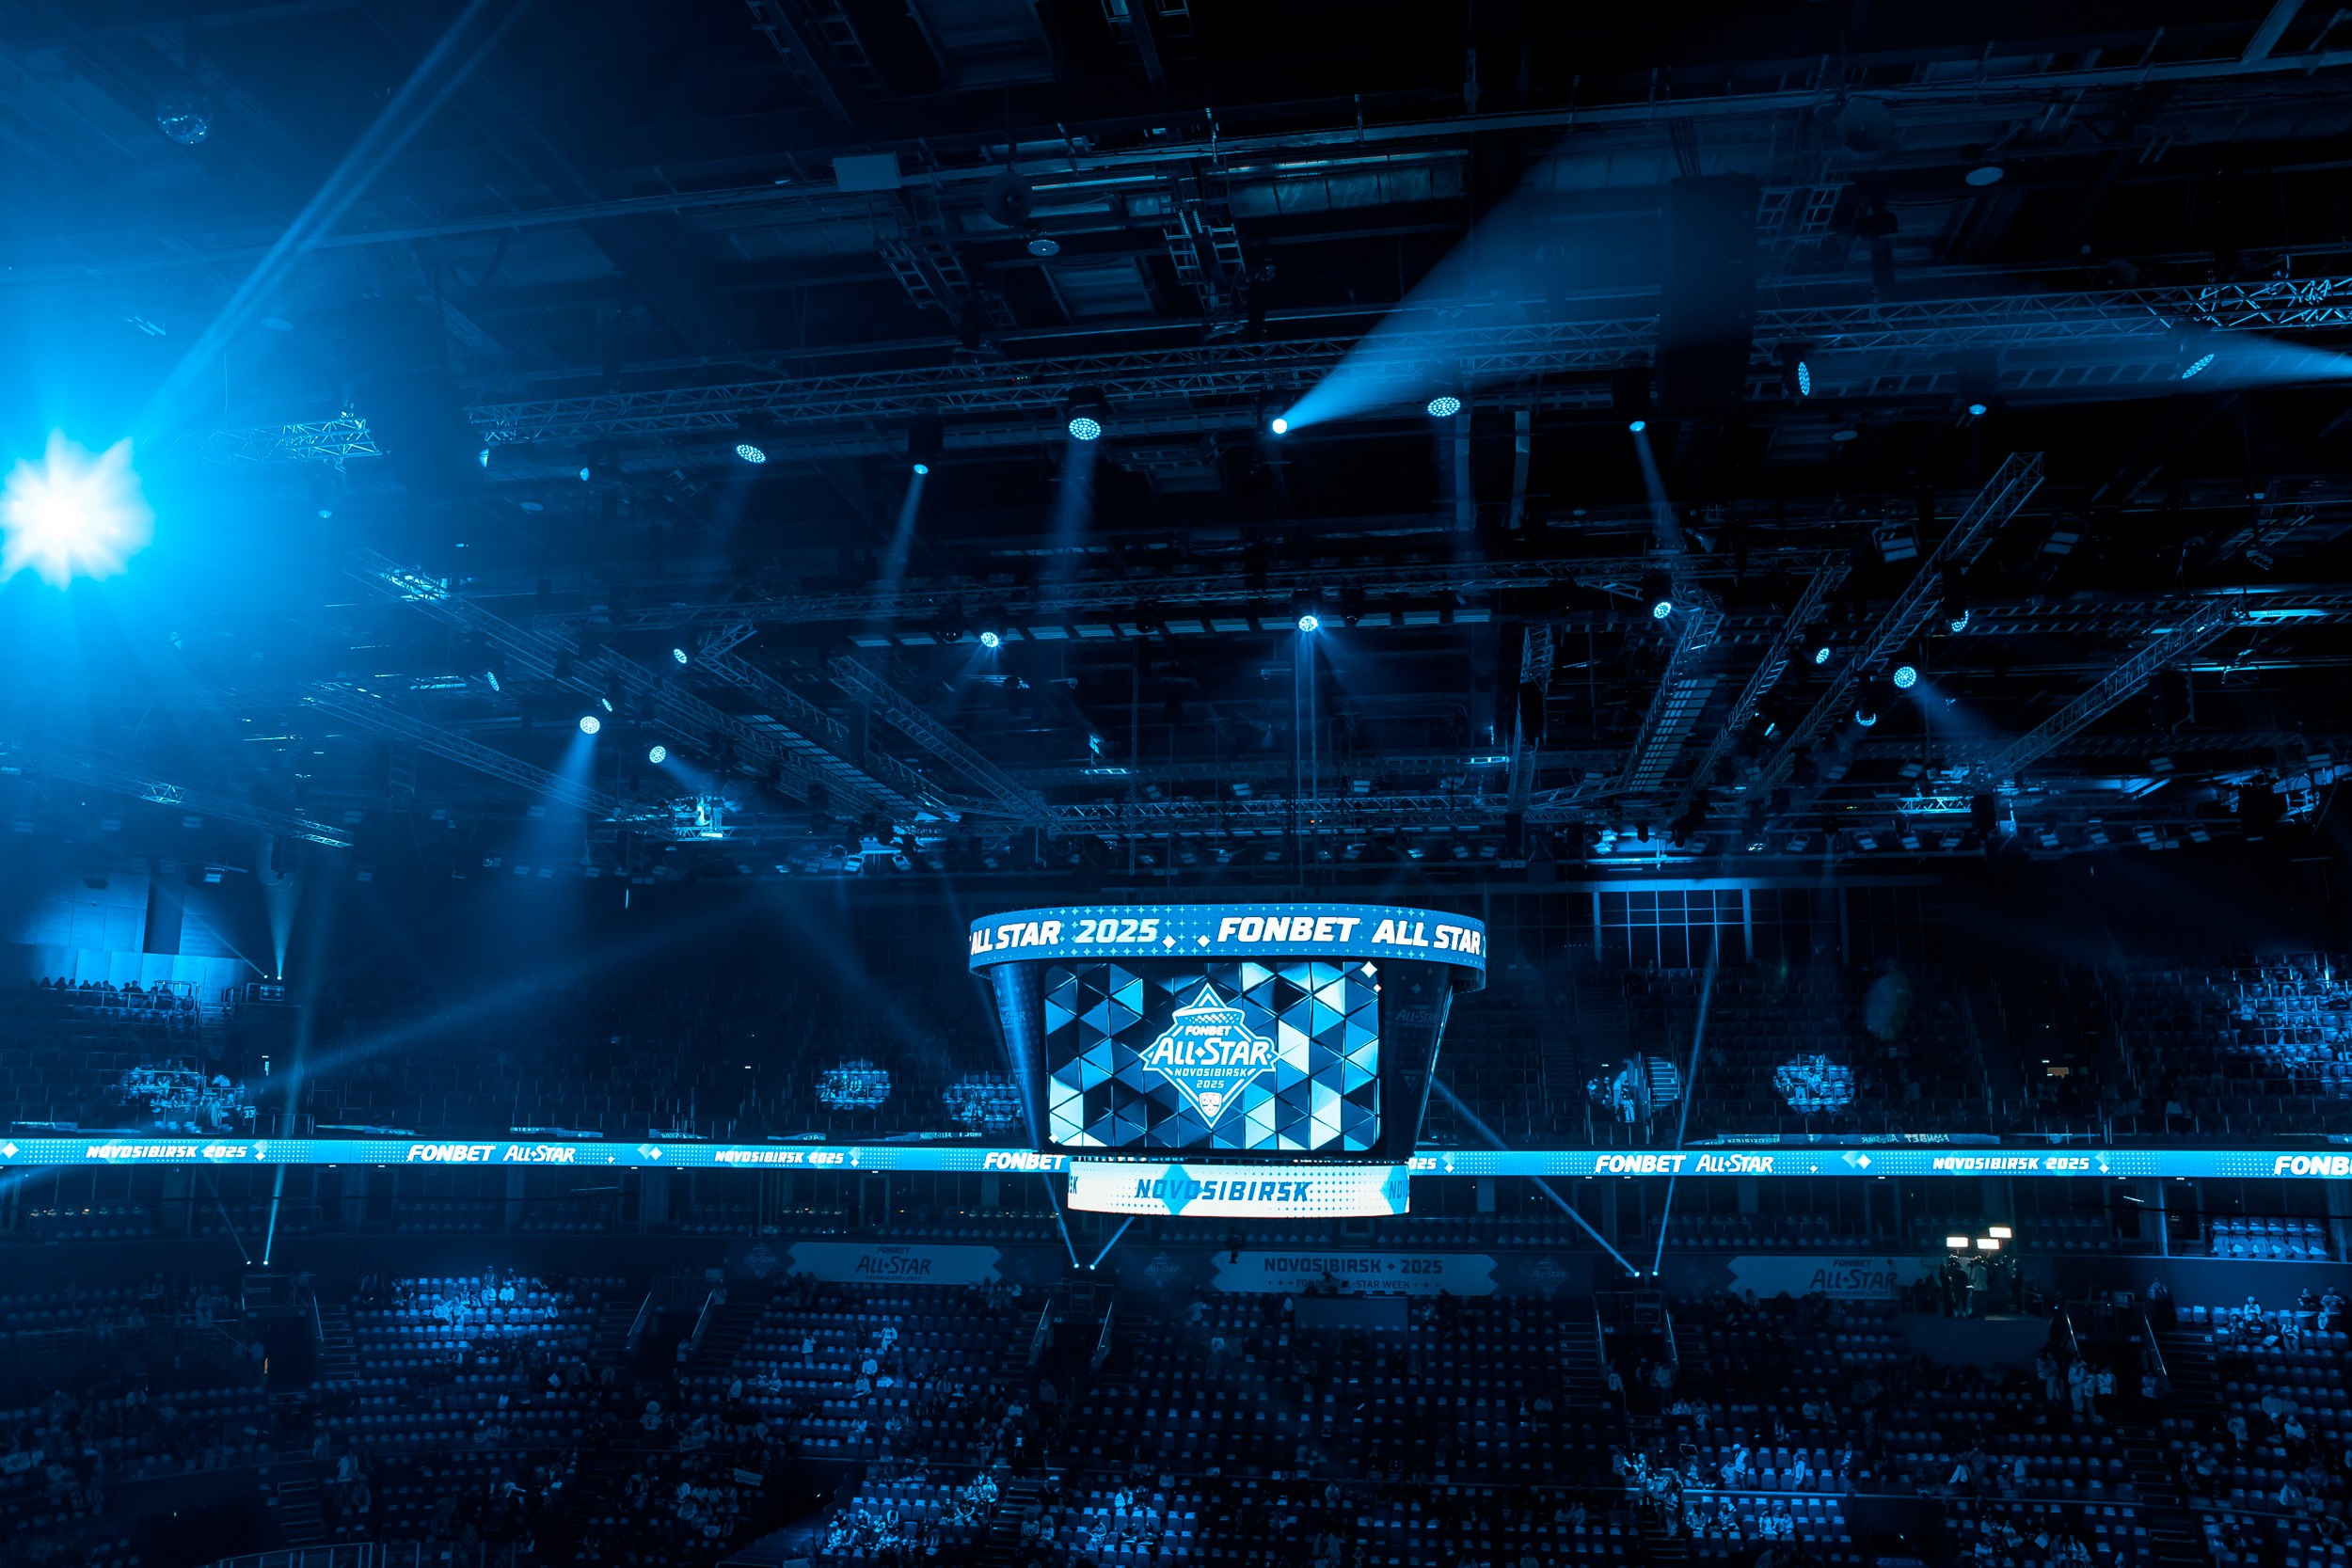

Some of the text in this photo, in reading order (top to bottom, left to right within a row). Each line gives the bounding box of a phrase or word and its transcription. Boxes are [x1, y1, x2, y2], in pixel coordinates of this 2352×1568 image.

[970, 927, 993, 956] ALL
[995, 920, 1062, 949] STAR
[1074, 918, 1160, 943] 2025
[1217, 916, 1361, 942] FONBET
[1371, 919, 1429, 947] ALL
[1433, 924, 1481, 955] STAR
[1184, 1025, 1232, 1036] FONBET
[1174, 1068, 1248, 1077] NOVOSIBIRSK
[1196, 1080, 1225, 1088] 2025
[86, 1146, 248, 1158] NOVOSIBIRSK 2025
[406, 1145, 496, 1162] FONBET
[714, 1150, 844, 1164] NOVOSIBIRSK 2025
[983, 1151, 1066, 1170] FONBET
[1594, 1154, 1686, 1174] FONBET
[1932, 1157, 2090, 1170] NOVOSIBIRSK 2025
[2274, 1156, 2352, 1176] FONB
[1135, 1179, 1311, 1202] NOVOSIBIRSK
[1264, 1258, 1442, 1274] NOVOSIBIRSK 2025
[1383, 1280, 1409, 1289] WEEK
